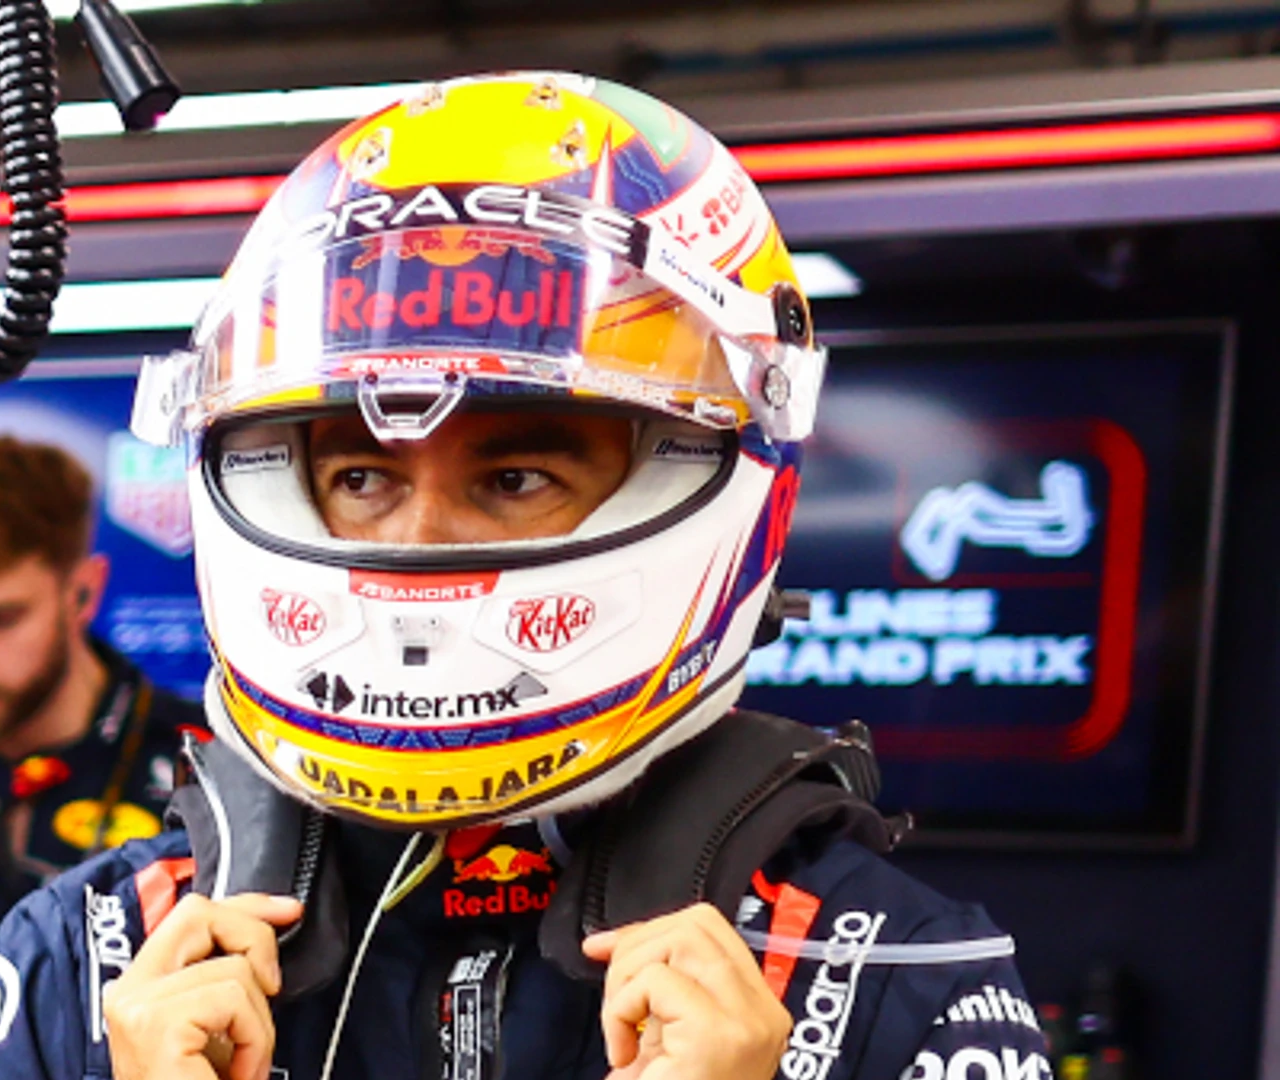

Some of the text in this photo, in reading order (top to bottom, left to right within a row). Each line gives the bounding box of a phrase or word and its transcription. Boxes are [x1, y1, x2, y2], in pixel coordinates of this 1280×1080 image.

[327, 268, 572, 332] Red Bull
[380, 583, 484, 600] BANORTE
[783, 589, 995, 635] LINES
[518, 597, 590, 649] KitKat
[744, 635, 1091, 685] RAND PRIX
[360, 683, 521, 719] inter.mx
[298, 740, 587, 813] UADALAJARA
[443, 887, 505, 917] Red
